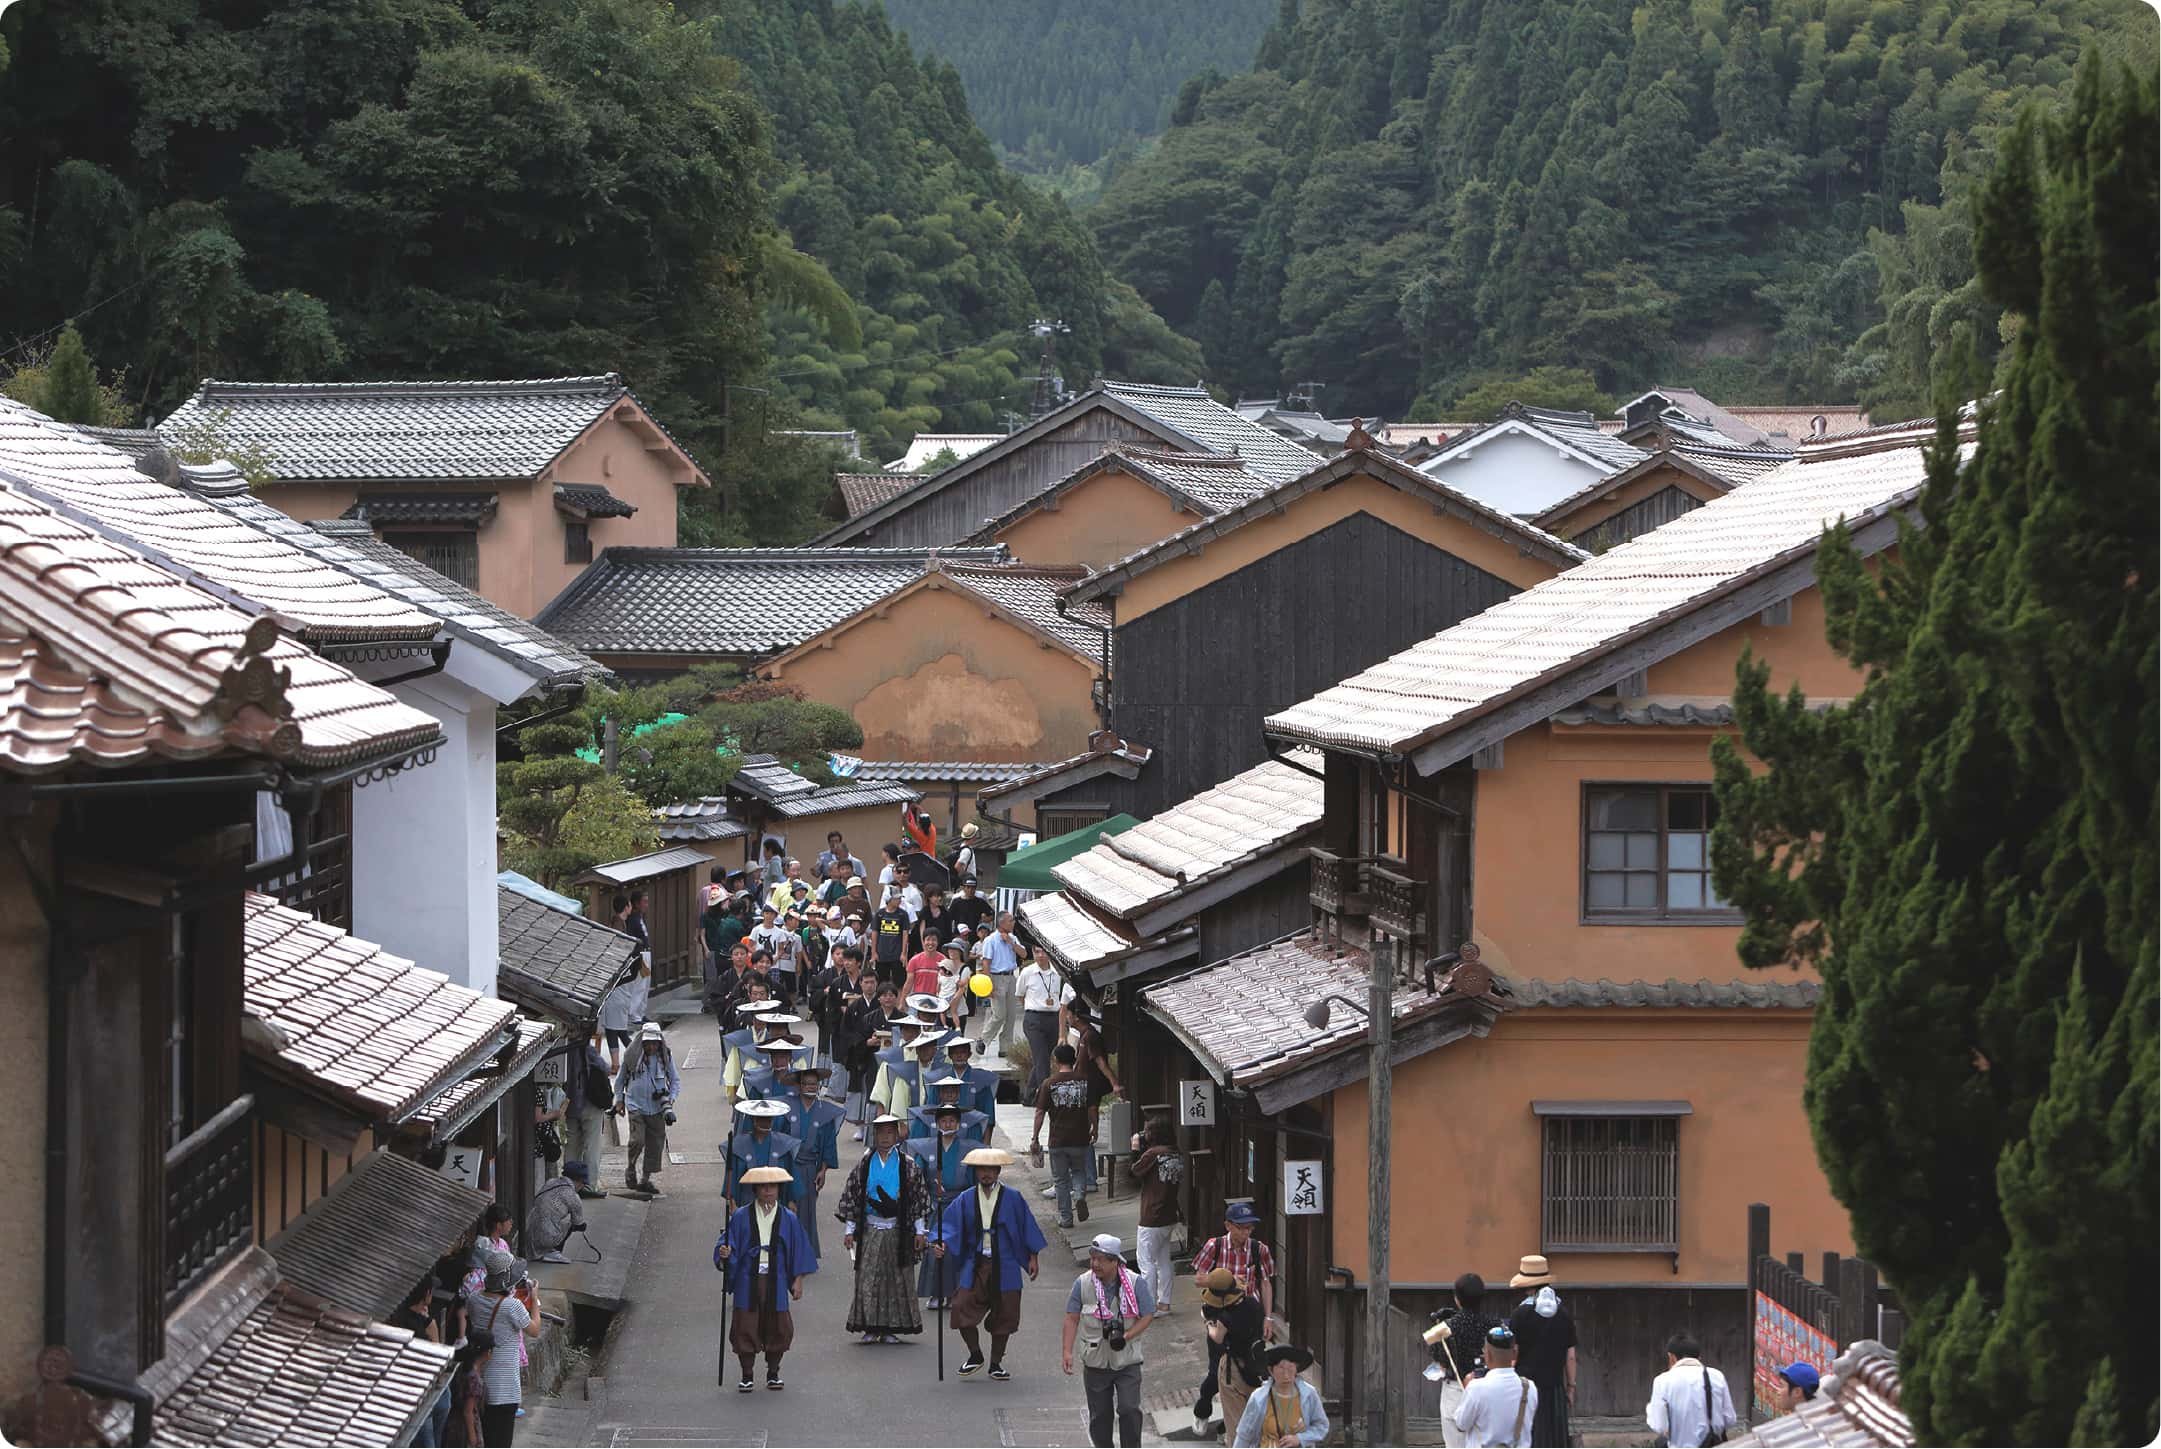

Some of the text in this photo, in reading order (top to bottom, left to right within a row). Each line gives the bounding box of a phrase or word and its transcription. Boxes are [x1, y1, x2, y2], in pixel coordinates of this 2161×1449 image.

[1188, 1085, 1207, 1119] 天領
[450, 1154, 470, 1182] 天
[1290, 1167, 1317, 1209] 天領
